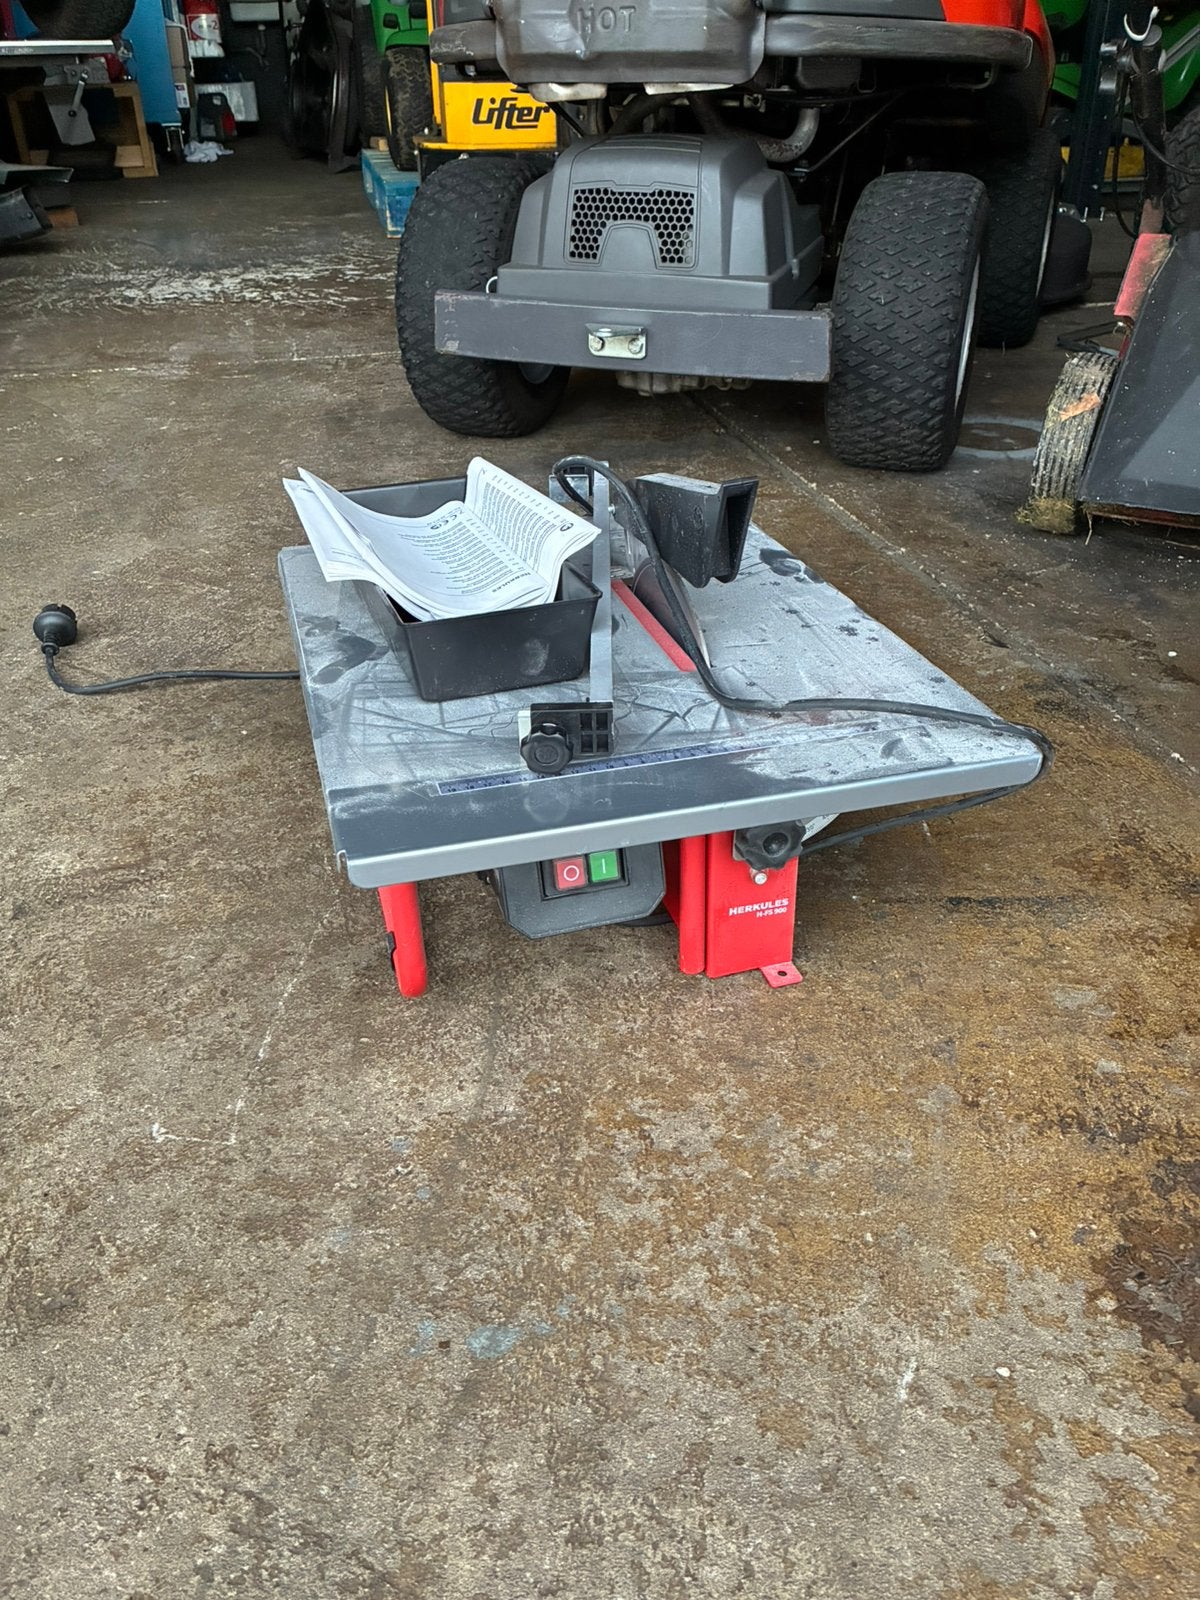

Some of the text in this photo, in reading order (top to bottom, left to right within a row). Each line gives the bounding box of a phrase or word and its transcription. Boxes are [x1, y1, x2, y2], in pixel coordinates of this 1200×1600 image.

[577, 6, 636, 34] HOT
[472, 96, 550, 130] Lifter
[729, 897, 789, 916] HERKULES
[756, 907, 787, 918] H-FS 900
